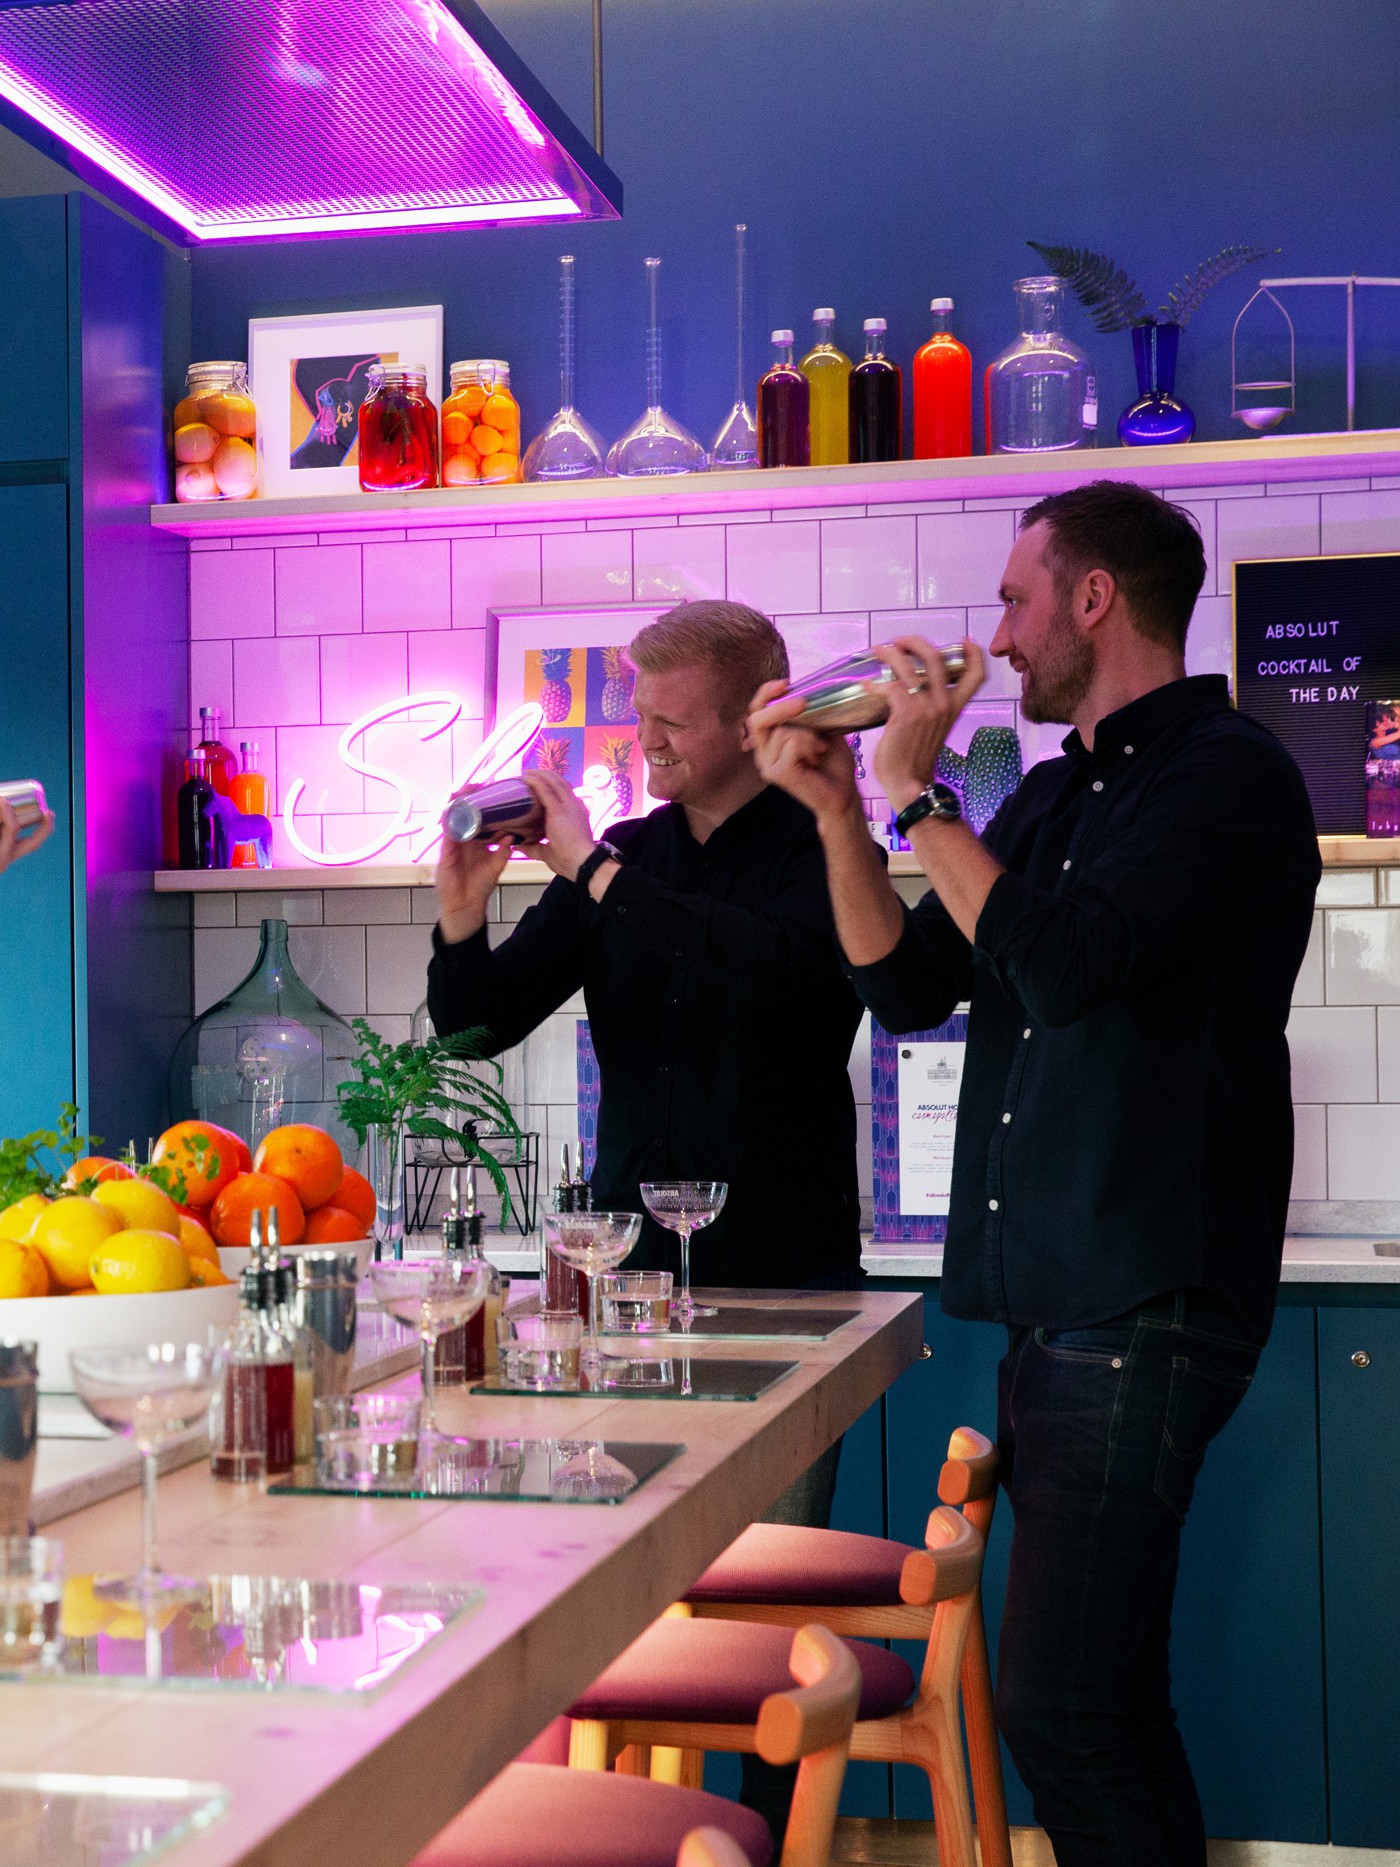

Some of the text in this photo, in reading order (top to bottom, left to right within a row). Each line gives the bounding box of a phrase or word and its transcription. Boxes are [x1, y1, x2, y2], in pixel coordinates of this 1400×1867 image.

[1265, 620, 1339, 639] ABSOLUT
[1258, 656, 1362, 675] COCKTAIL OF
[1289, 685, 1359, 703] THE DAY
